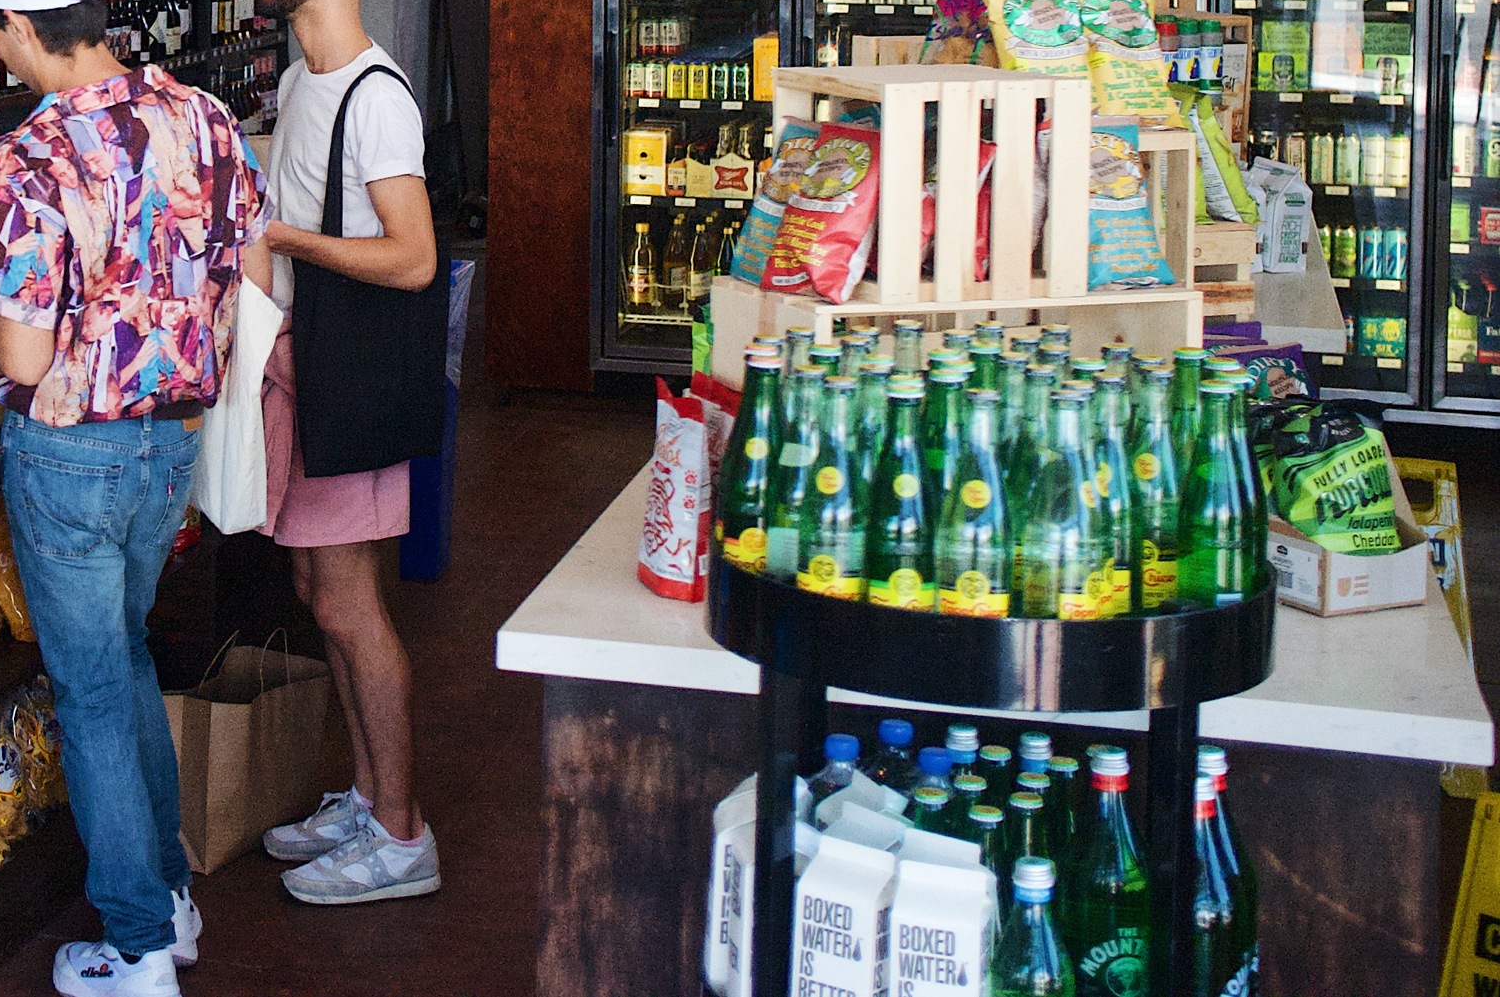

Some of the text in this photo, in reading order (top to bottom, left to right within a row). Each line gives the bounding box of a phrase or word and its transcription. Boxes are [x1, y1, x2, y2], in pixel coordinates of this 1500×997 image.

[1314, 460, 1348, 489] FULLY
[1352, 533, 1395, 548] Cheddar
[803, 895, 853, 931] BOXED
[802, 922, 853, 955] WATER
[900, 924, 956, 956] BOXED
[800, 951, 815, 977] IS
[899, 952, 956, 987] WATER
[1080, 939, 1147, 978] MOUNT
